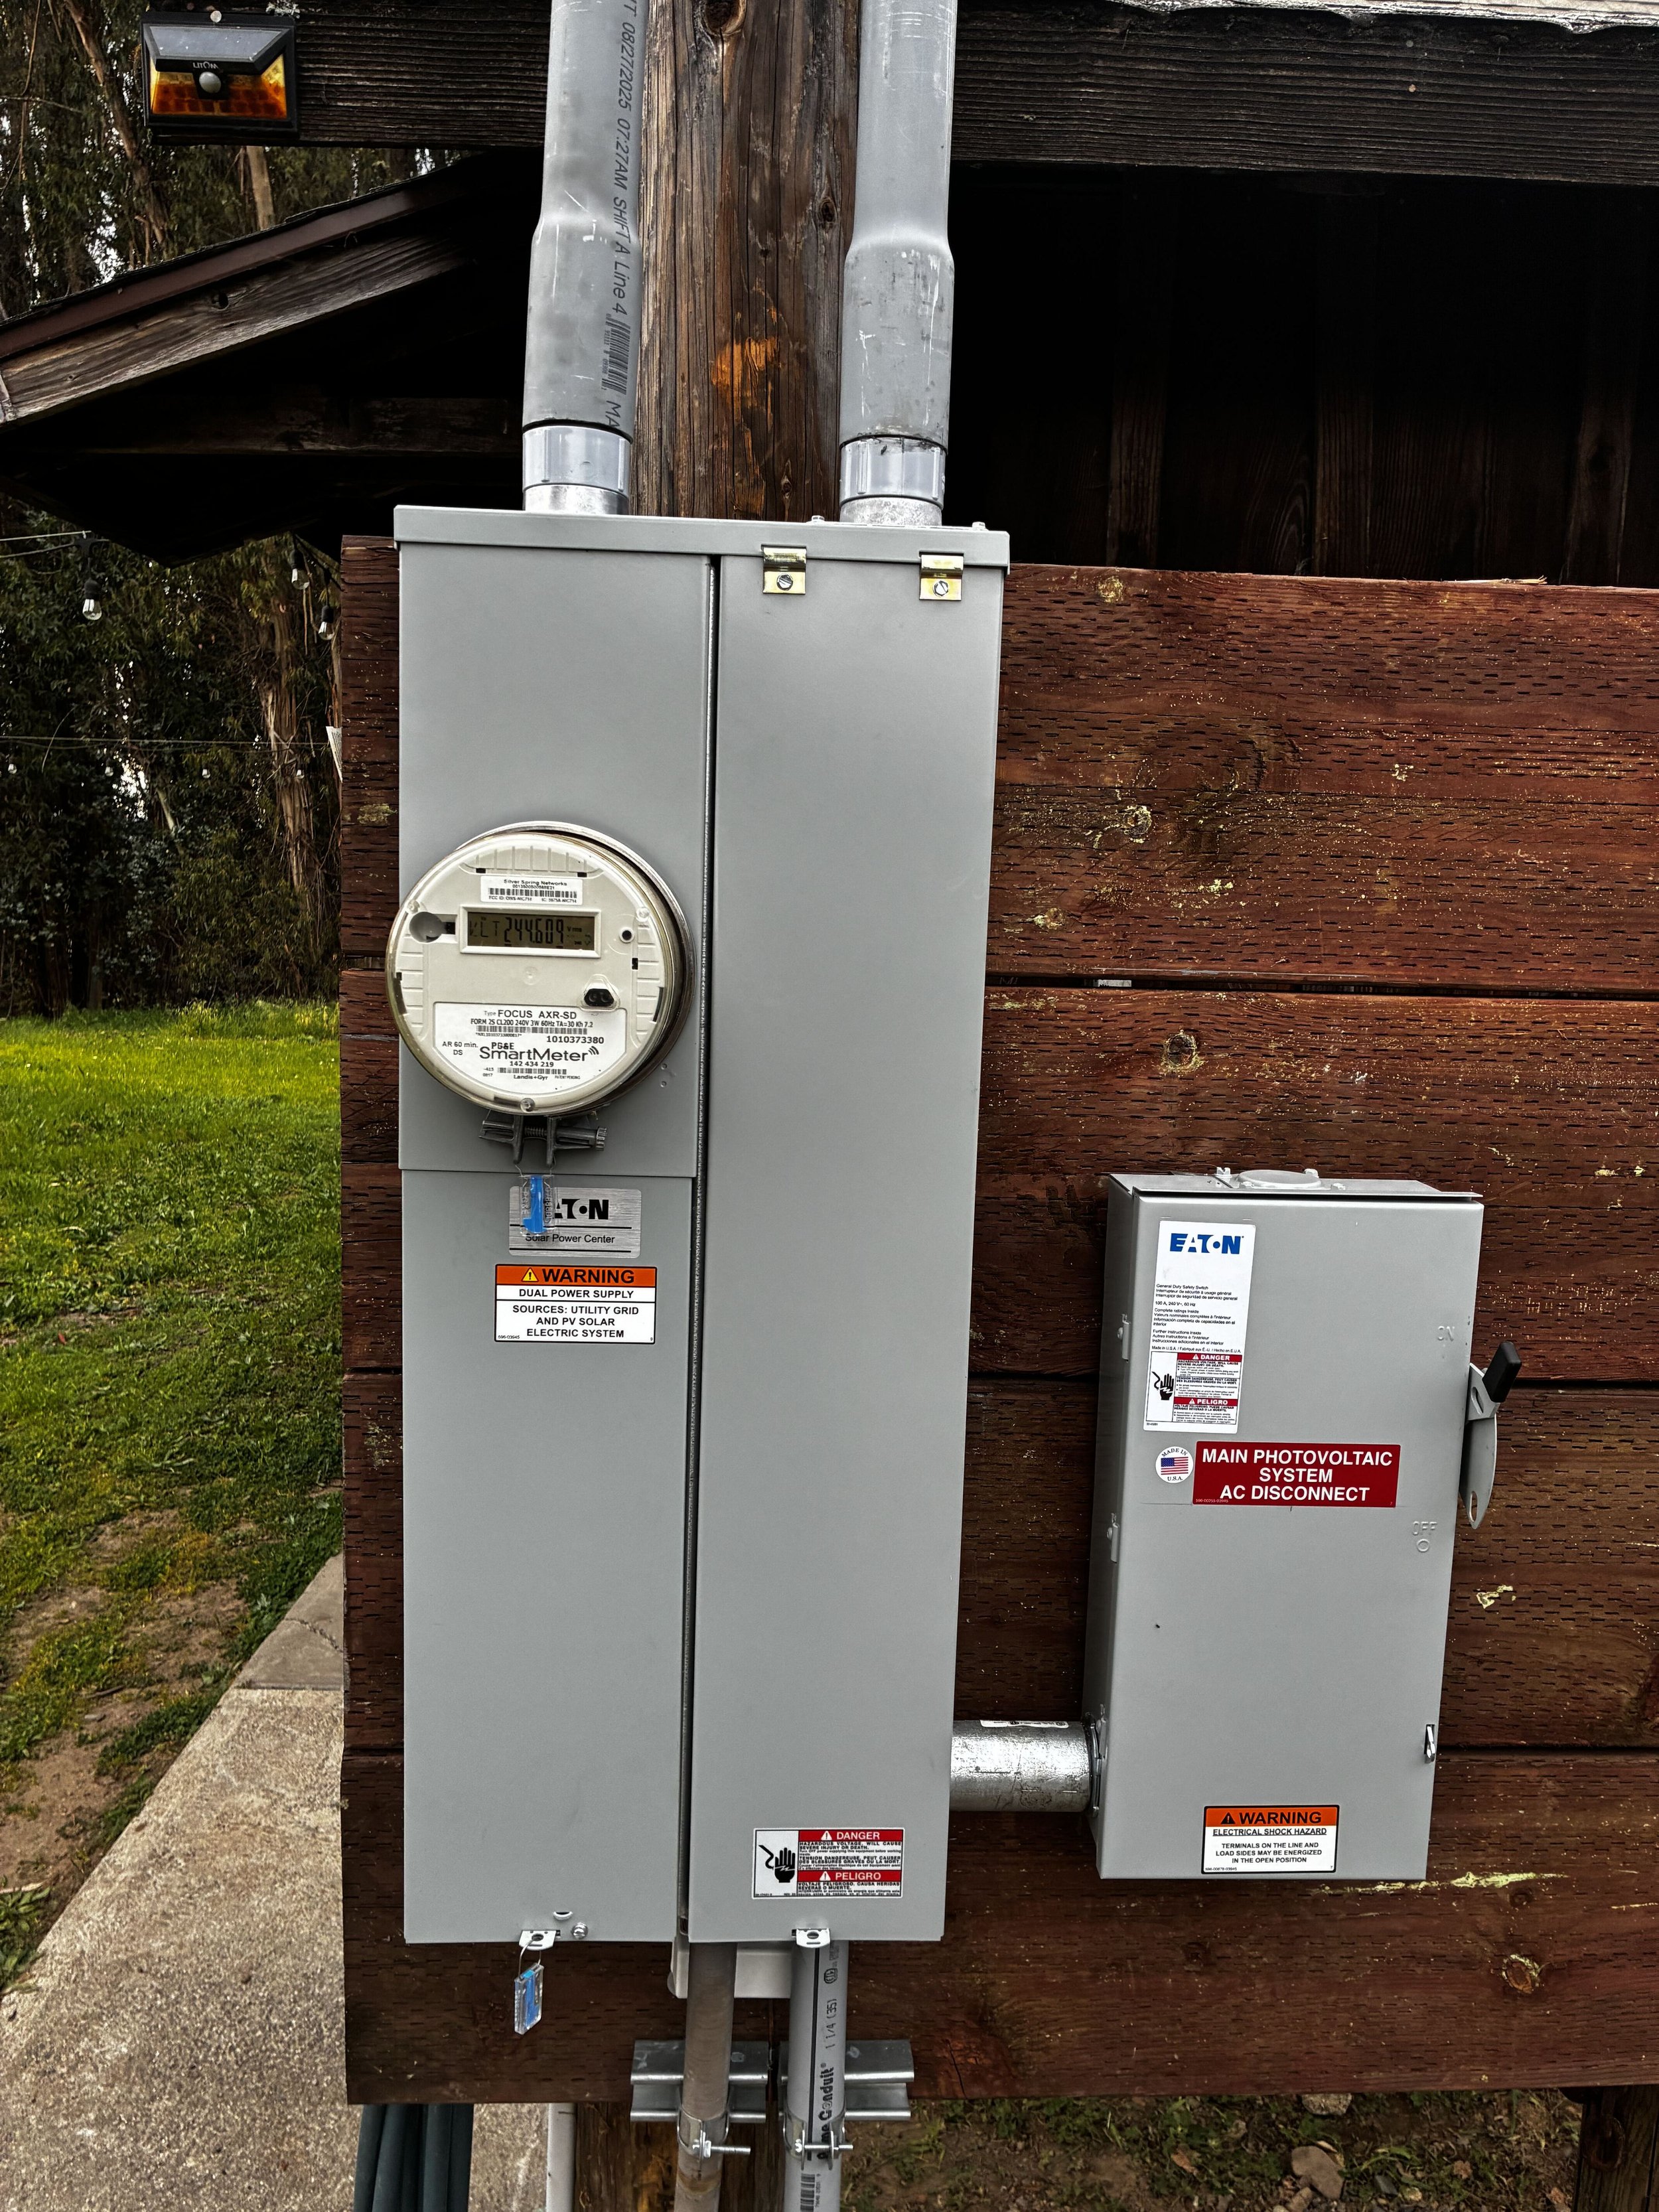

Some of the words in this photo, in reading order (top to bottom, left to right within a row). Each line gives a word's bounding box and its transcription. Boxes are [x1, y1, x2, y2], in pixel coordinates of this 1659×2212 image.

[618, 22, 636, 111] 08/27/2025
[613, 196, 631, 243] SHIFT
[615, 242, 630, 254] A
[613, 261, 630, 299] Line
[612, 303, 628, 315] 4
[498, 1009, 533, 1018] FOCUS
[546, 1035, 605, 1044] 1010373380
[479, 1046, 589, 1062] SmartMeter
[525, 1233, 549, 1242] Solar
[552, 1234, 581, 1243] Power
[585, 1234, 615, 1243] Center
[1169, 1233, 1241, 1254] EATON
[542, 1268, 634, 1284] WARNING
[519, 1289, 547, 1297] DUAL
[551, 1290, 590, 1298] POWER
[593, 1290, 634, 1299] SUPPLY
[512, 1305, 567, 1314] SOURCES:
[571, 1306, 610, 1315] UTILITY
[526, 1329, 578, 1337] ELECTRIC
[582, 1329, 624, 1338] SYSTEM
[1161, 1448, 1179, 1457] MADE
[1202, 1448, 1248, 1463] MAIN
[1254, 1449, 1393, 1466] PHOTOVOLTAIC
[1260, 1467, 1333, 1483] SYSTEM
[1220, 1485, 1246, 1499] AC
[1252, 1485, 1370, 1501] DISCONNECT
[1413, 1521, 1437, 1536] OFF
[1239, 1811, 1321, 1824] WARNING
[818, 2067, 834, 2120] Conduit
[827, 1998, 837, 2019] (35)
